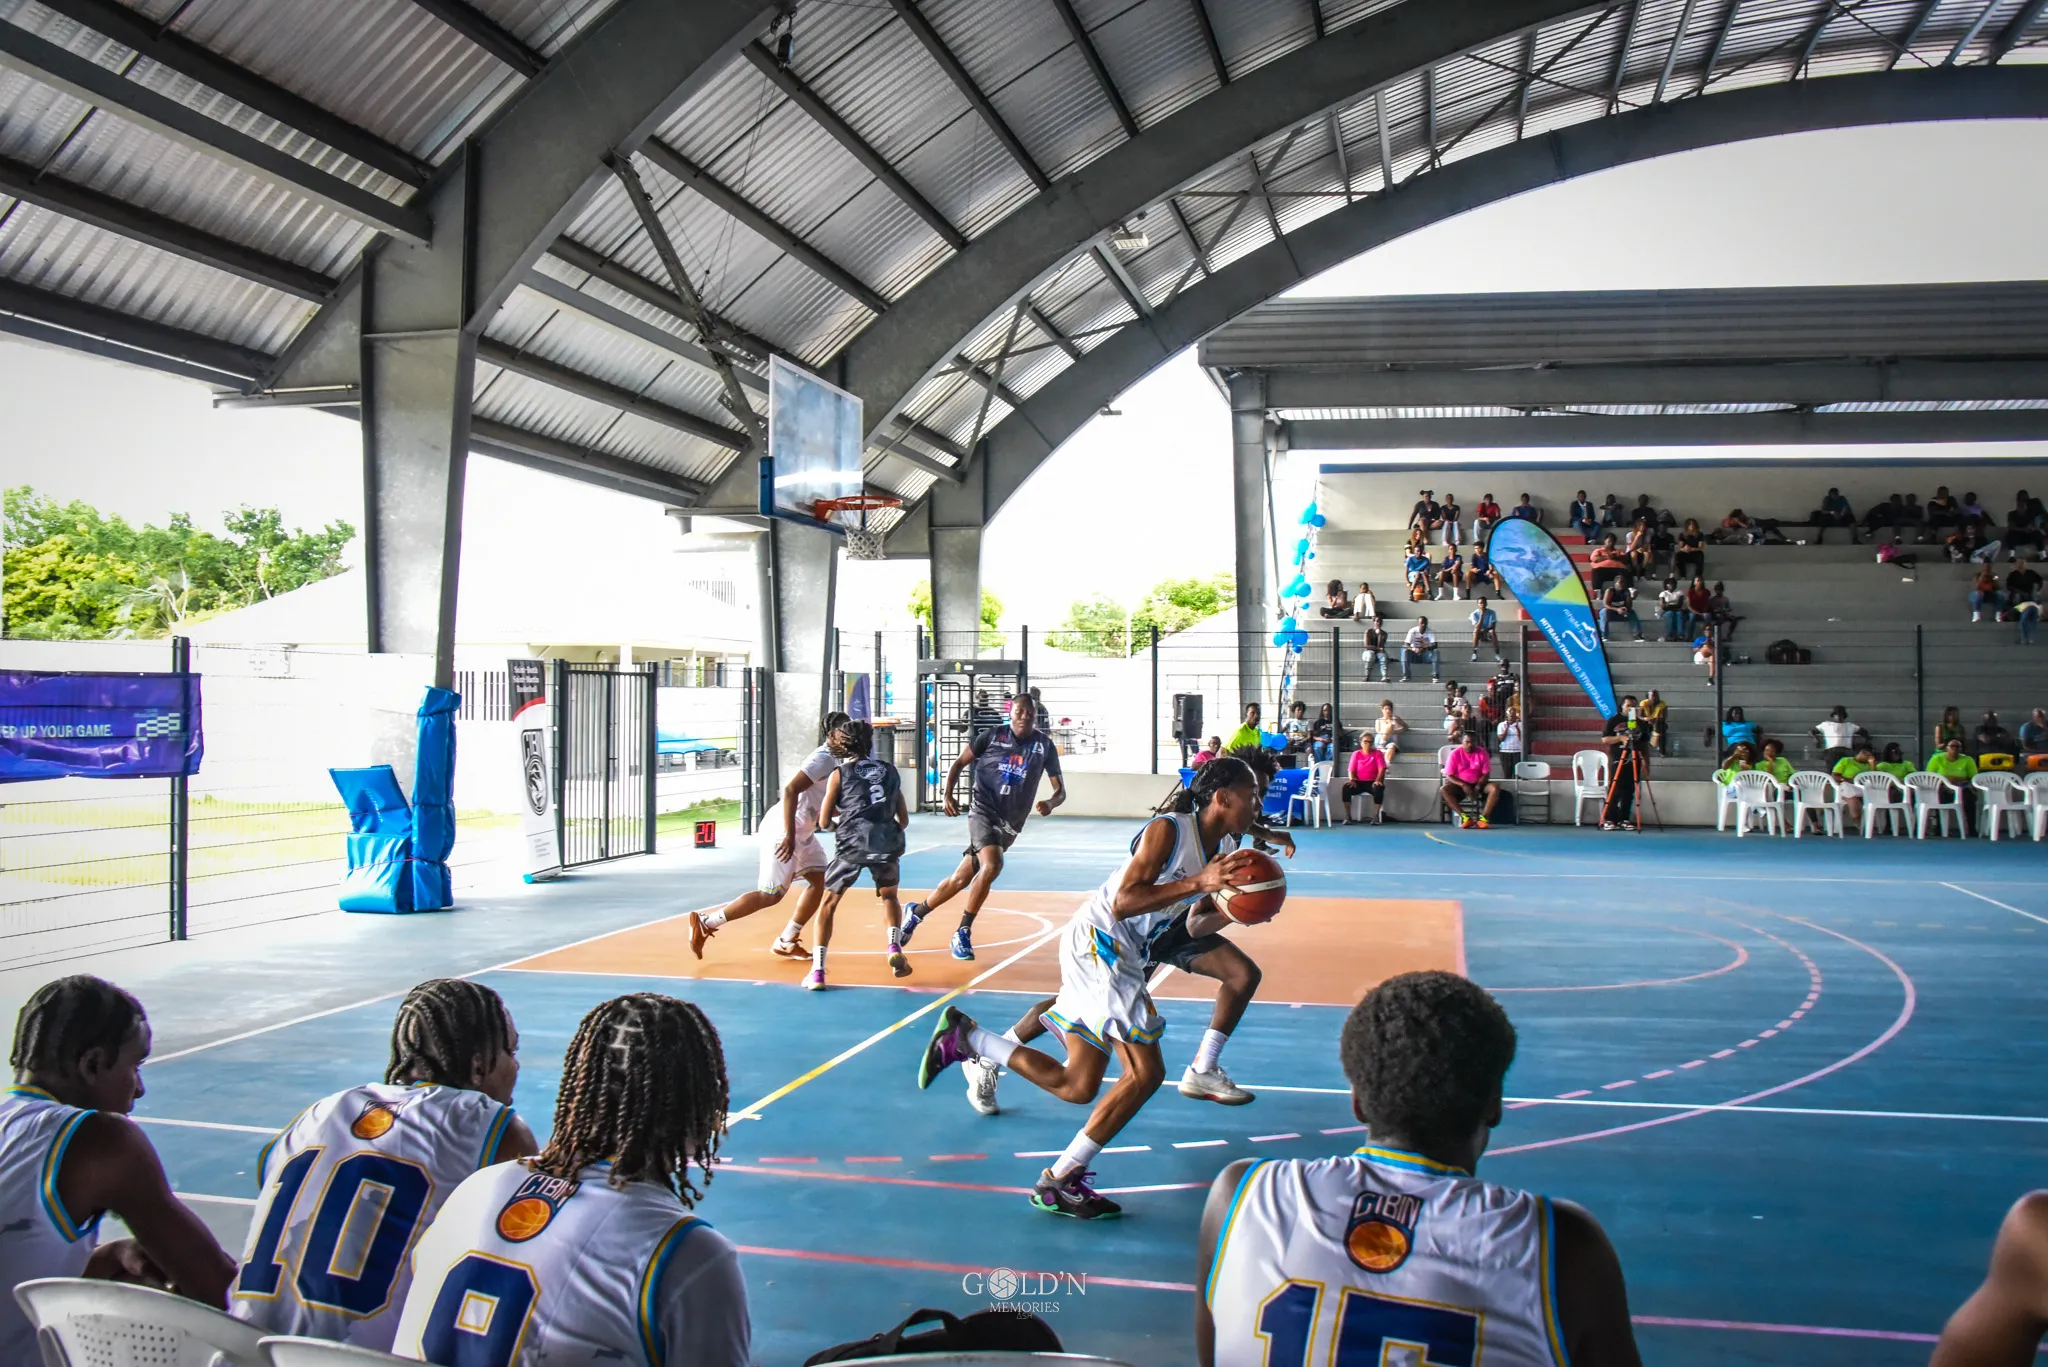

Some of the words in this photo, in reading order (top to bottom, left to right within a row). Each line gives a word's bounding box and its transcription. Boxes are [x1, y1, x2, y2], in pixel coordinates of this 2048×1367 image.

[0, 725, 18, 739] EP
[20, 725, 38, 739] UP
[40, 725, 74, 738] YOUR
[76, 724, 113, 737] GAME.
[869, 784, 887, 805] 2
[695, 822, 715, 844] 20
[233, 1146, 436, 1320] 10
